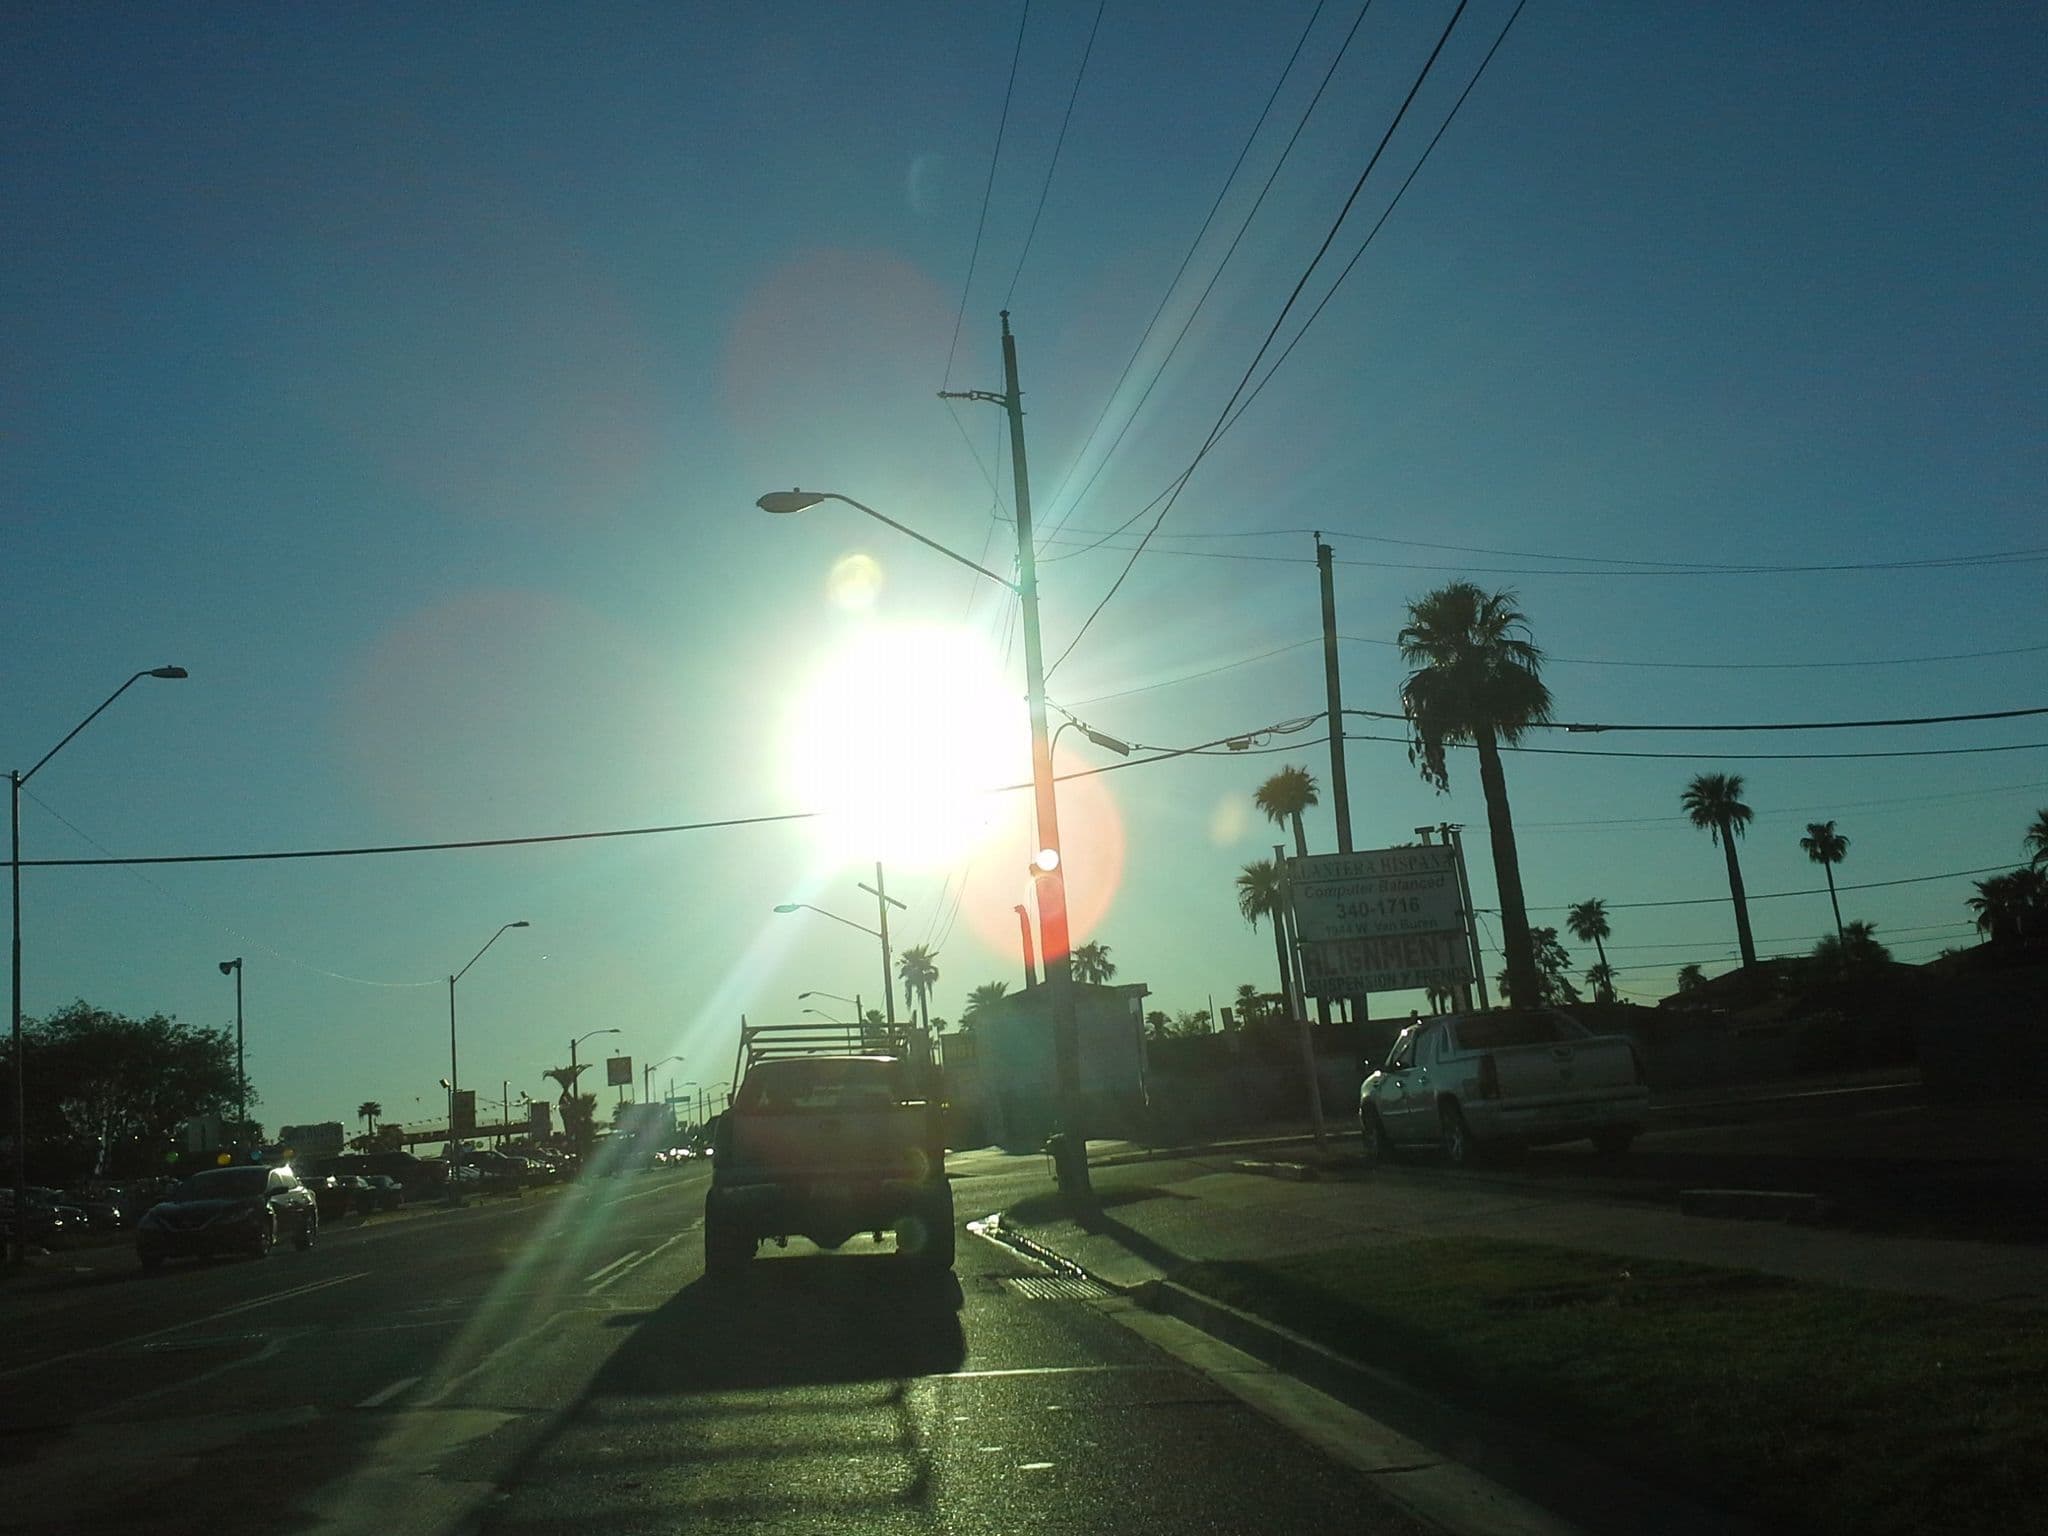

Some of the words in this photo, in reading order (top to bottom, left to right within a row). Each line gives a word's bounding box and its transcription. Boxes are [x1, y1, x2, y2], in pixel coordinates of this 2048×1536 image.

[1305, 882, 1373, 900] Computer
[1379, 876, 1444, 893] Balanced
[1337, 897, 1420, 919] 340-1716
[1306, 934, 1460, 975] ALIGNMENT
